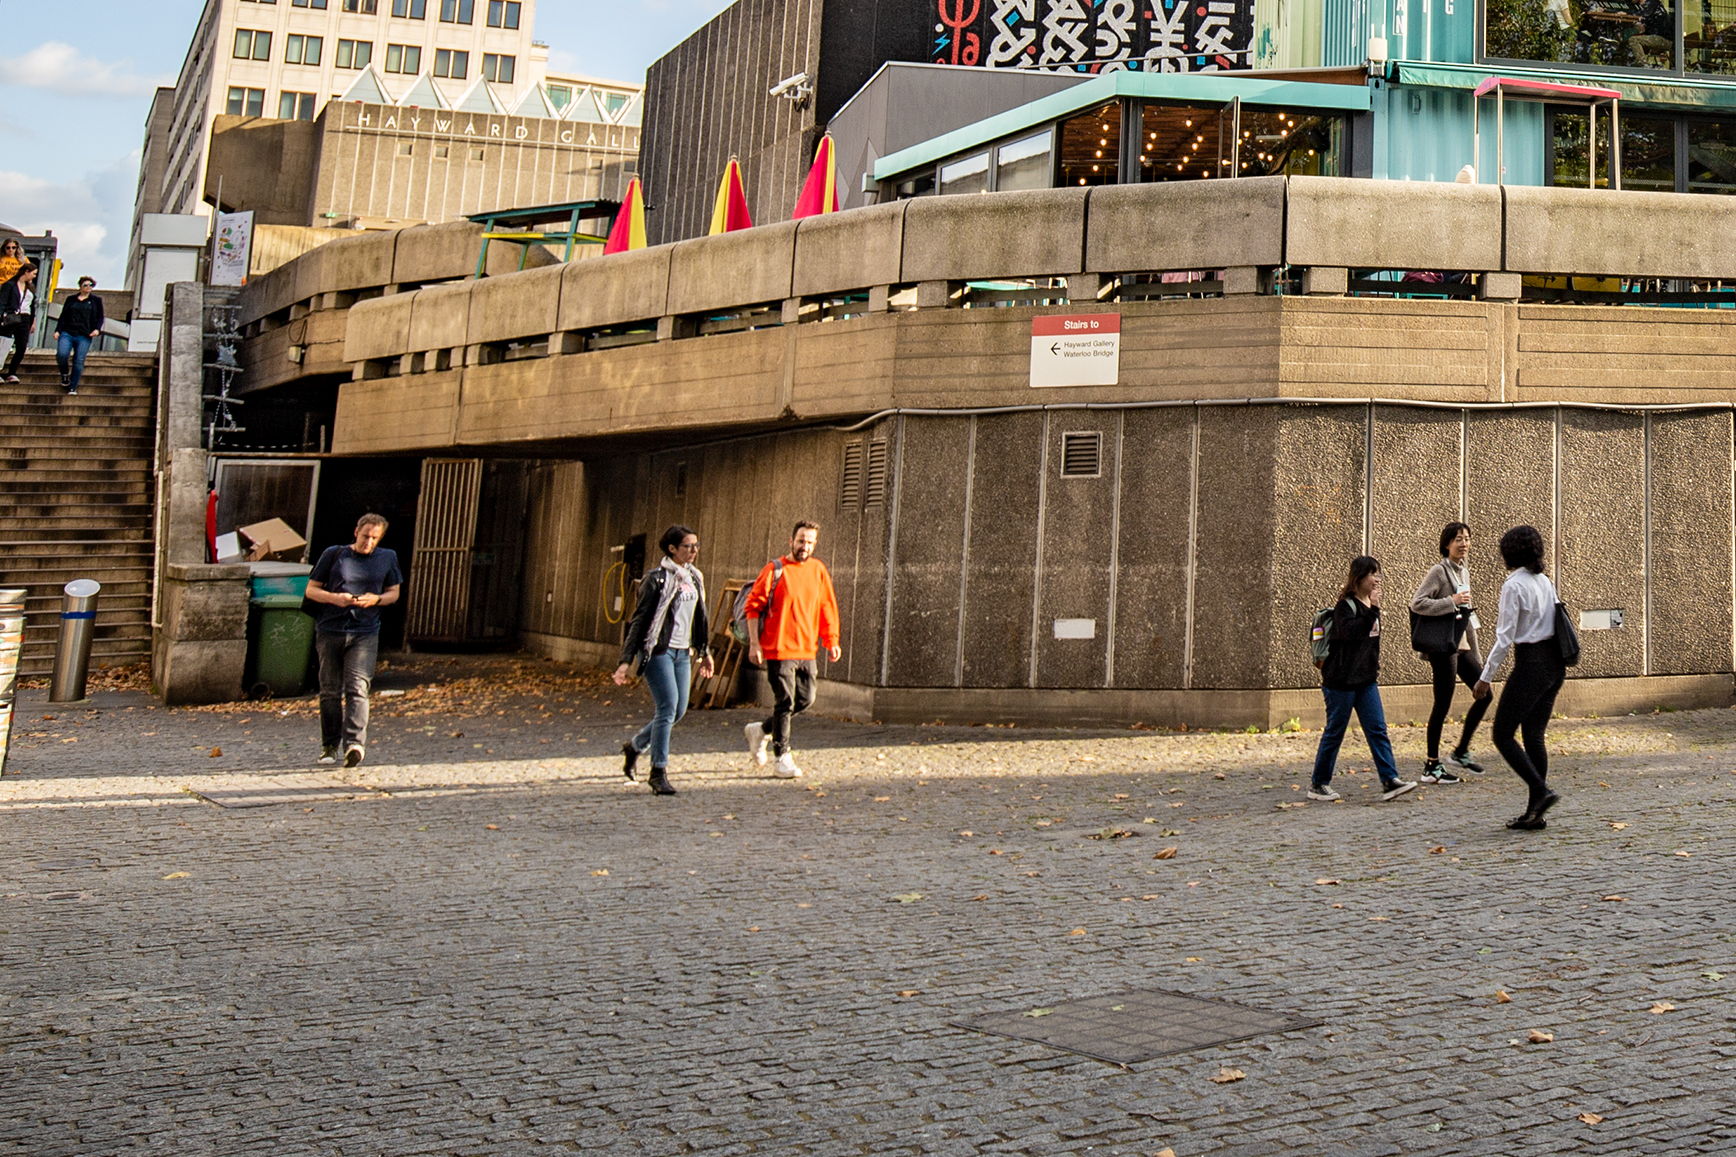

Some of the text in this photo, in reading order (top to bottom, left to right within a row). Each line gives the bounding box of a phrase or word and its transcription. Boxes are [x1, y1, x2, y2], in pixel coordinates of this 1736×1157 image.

[358, 113, 528, 140] HAYWARD
[1063, 320, 1099, 330] Stairs to
[1063, 340, 1115, 349] Hayward Gallery
[1063, 350, 1091, 358] Waterloo
